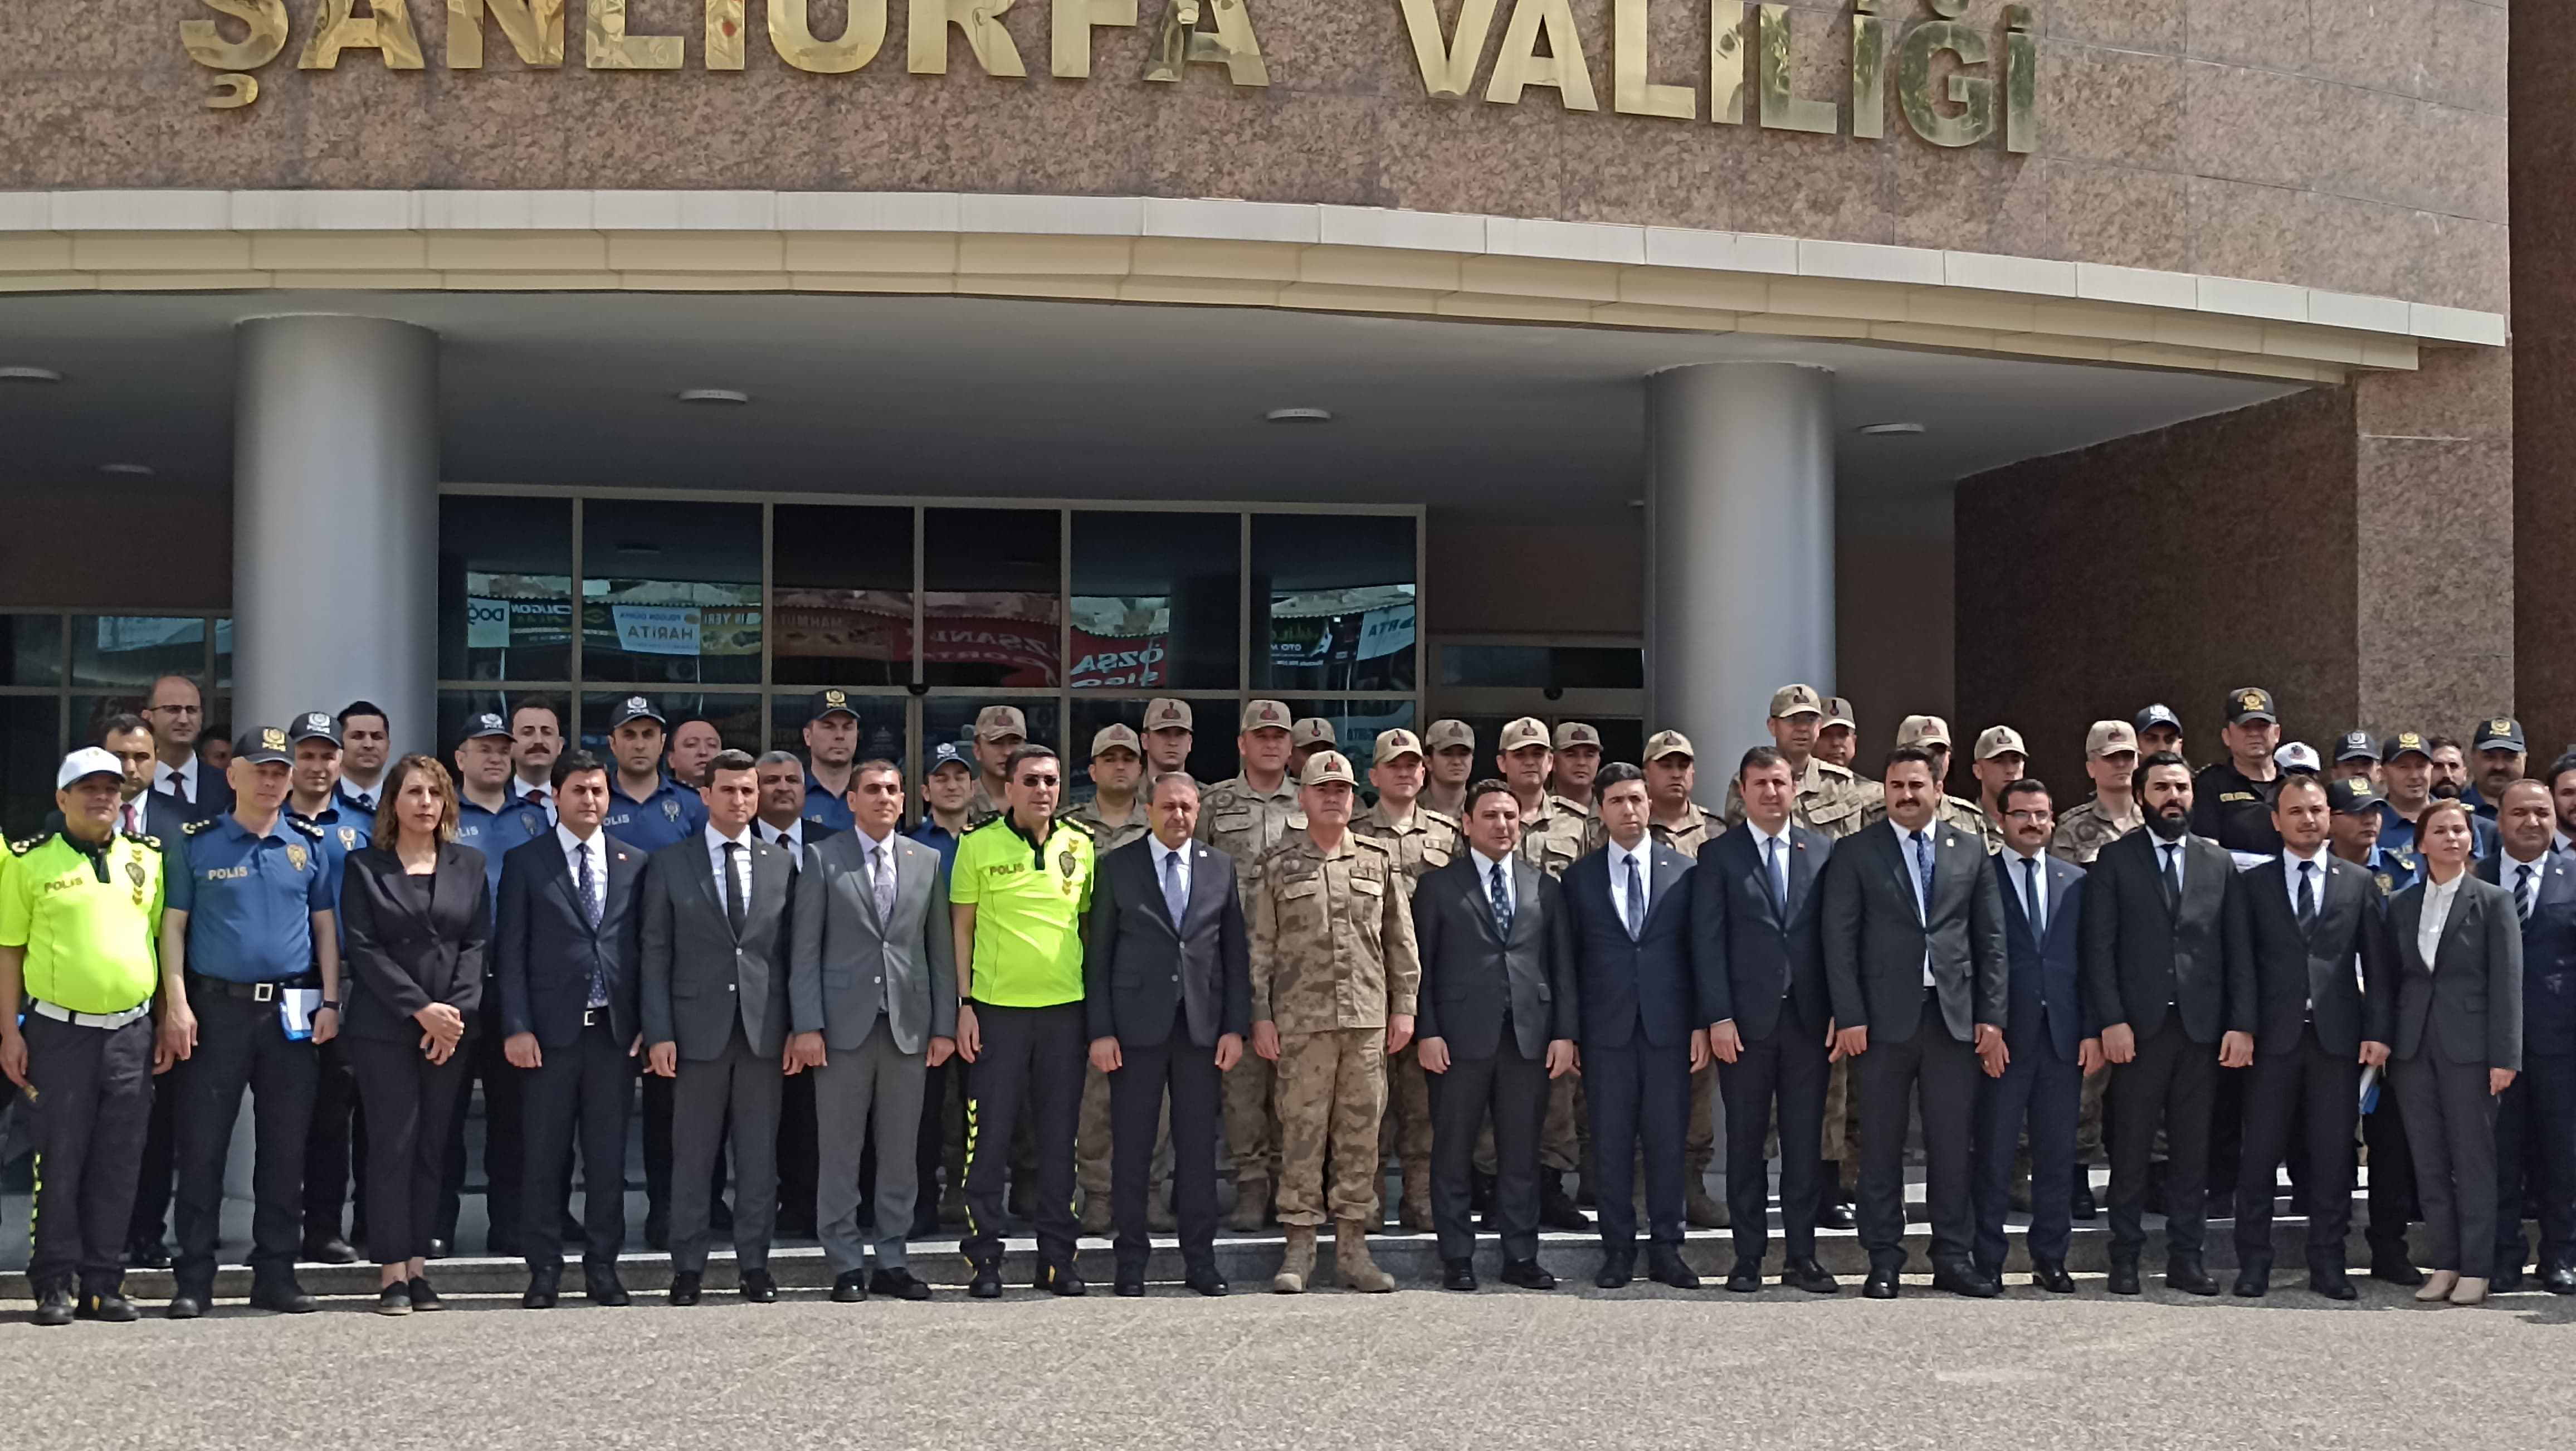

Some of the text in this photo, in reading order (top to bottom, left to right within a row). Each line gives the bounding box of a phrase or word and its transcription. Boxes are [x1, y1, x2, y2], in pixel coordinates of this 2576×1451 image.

[603, 814, 630, 826] OLIS
[458, 826, 479, 837] LIS
[208, 866, 248, 880] POLIS
[989, 863, 1024, 876] POLIS
[45, 877, 83, 893] POLIS
